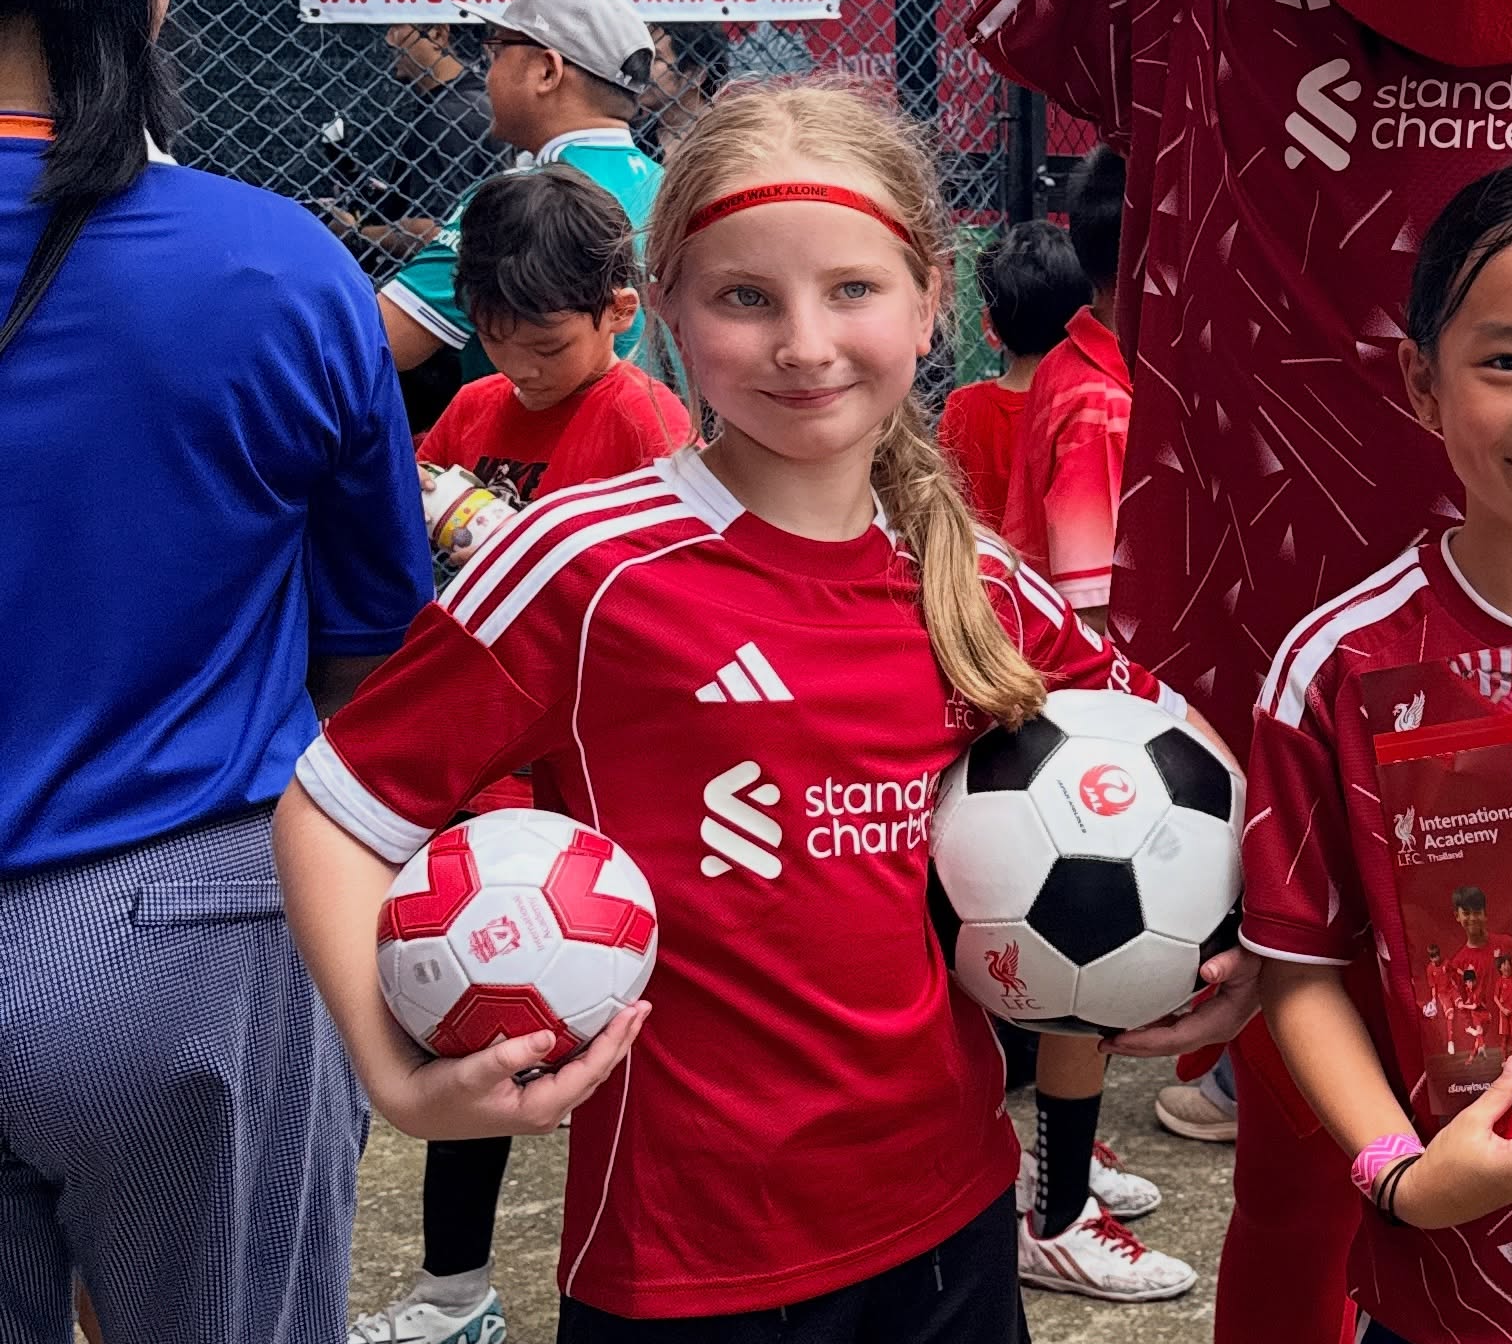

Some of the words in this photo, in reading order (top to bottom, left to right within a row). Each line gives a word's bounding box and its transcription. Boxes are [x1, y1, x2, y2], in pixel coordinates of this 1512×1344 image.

[747, 187, 783, 201] WALK
[785, 186, 828, 197] ALONE
[805, 771, 939, 818] stand
[1424, 828, 1499, 850] Academy
[1427, 849, 1464, 864] Thailand
